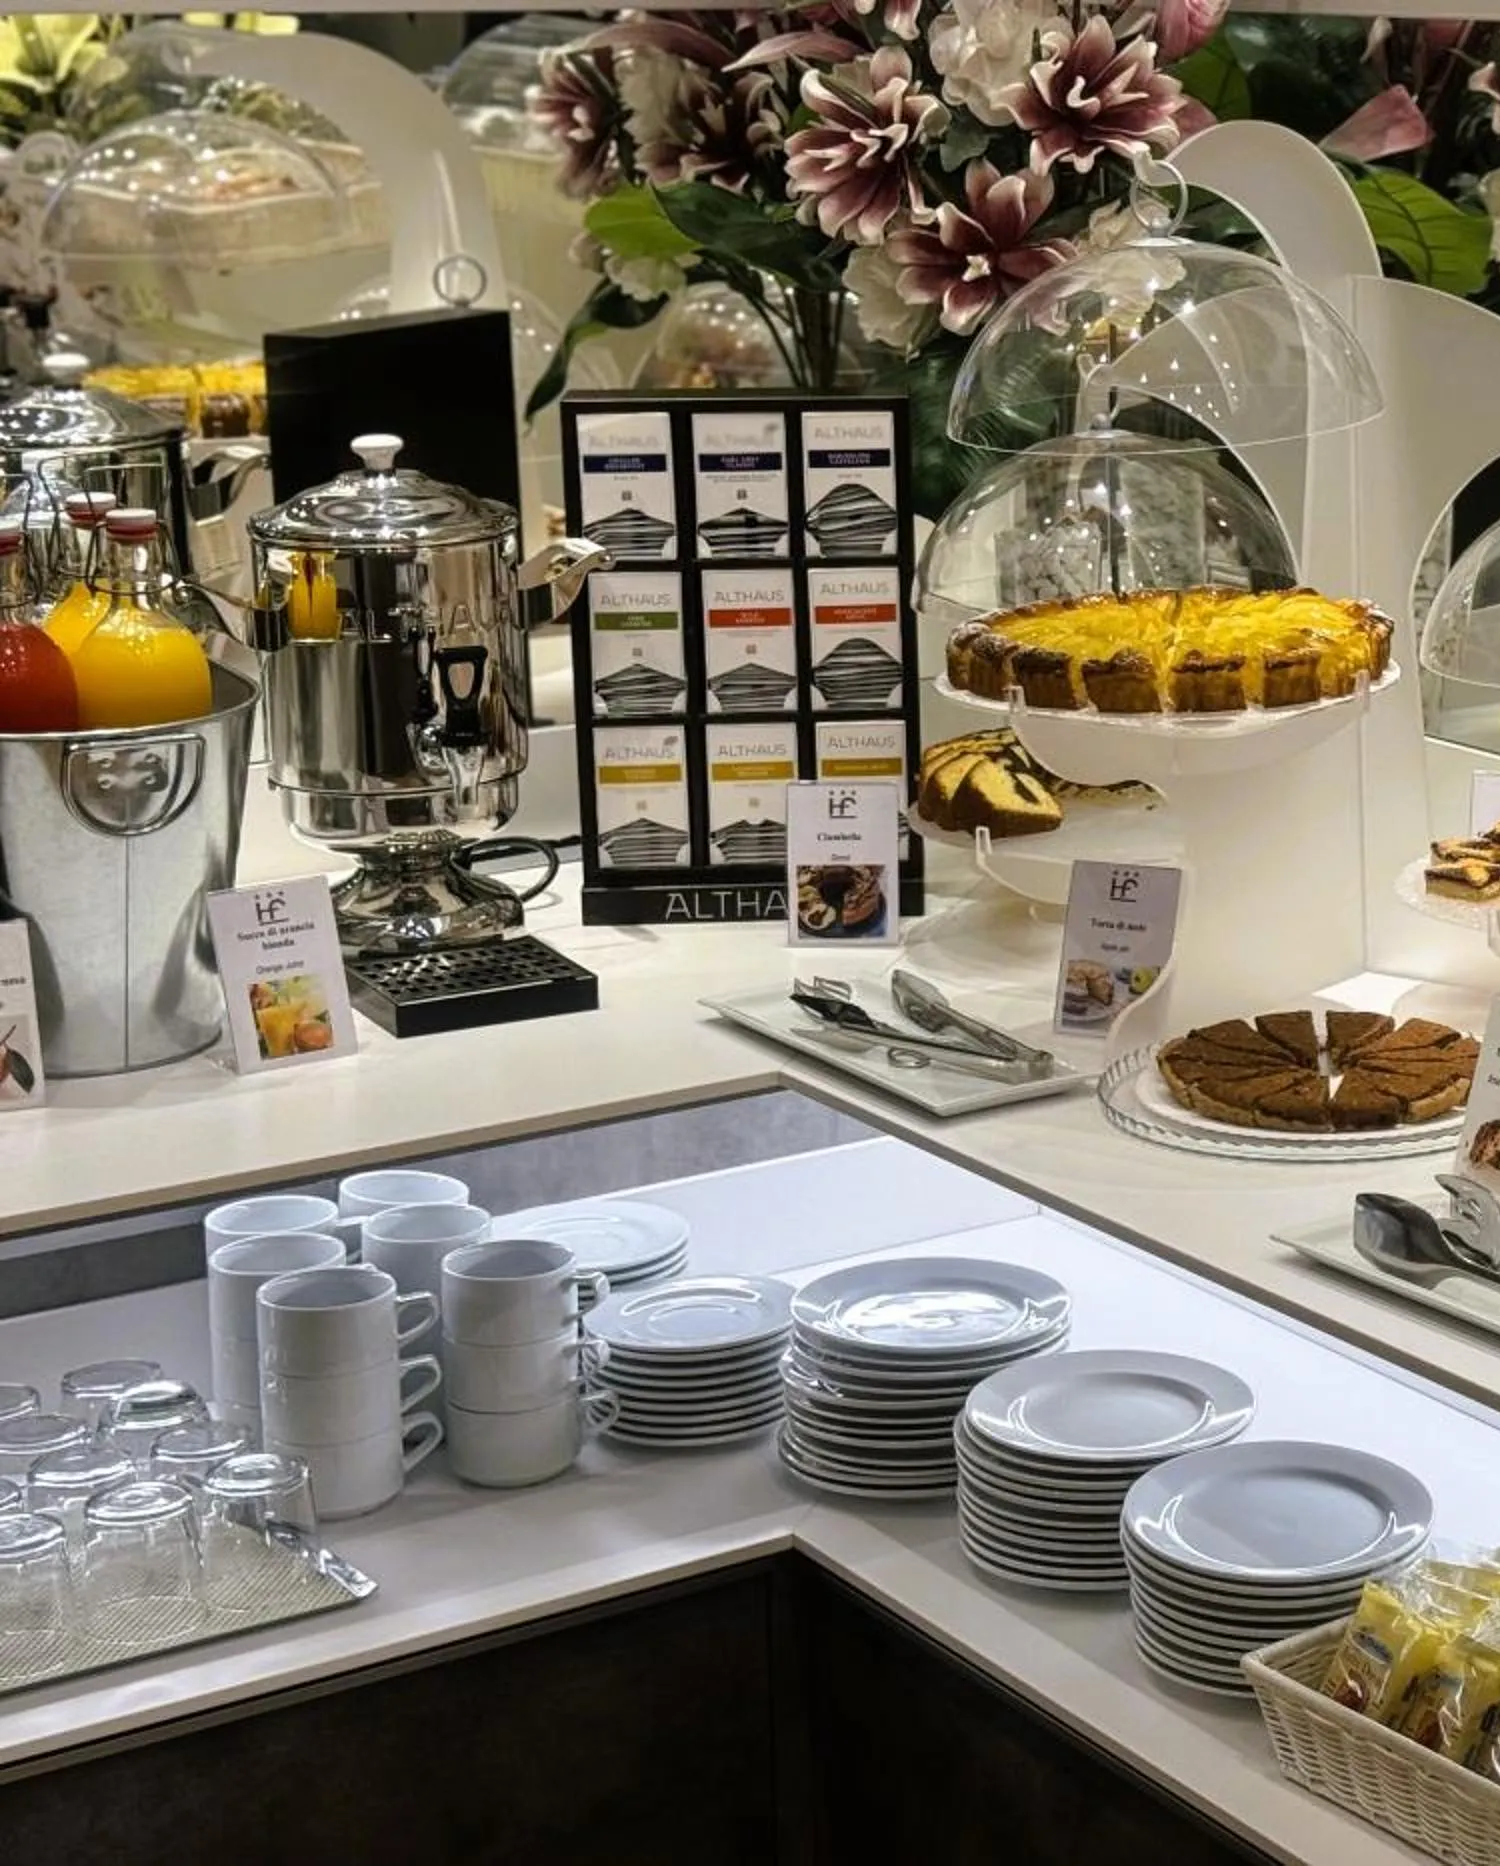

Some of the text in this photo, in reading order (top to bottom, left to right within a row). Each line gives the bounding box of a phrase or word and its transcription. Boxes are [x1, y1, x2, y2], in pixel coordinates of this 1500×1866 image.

[819, 582, 892, 596] ALTHAUS
[714, 590, 786, 603] ALTHAUS
[826, 735, 897, 750] ALTHAUS
[717, 743, 788, 757] ALTHAUS
[665, 889, 789, 922] ALTHA
